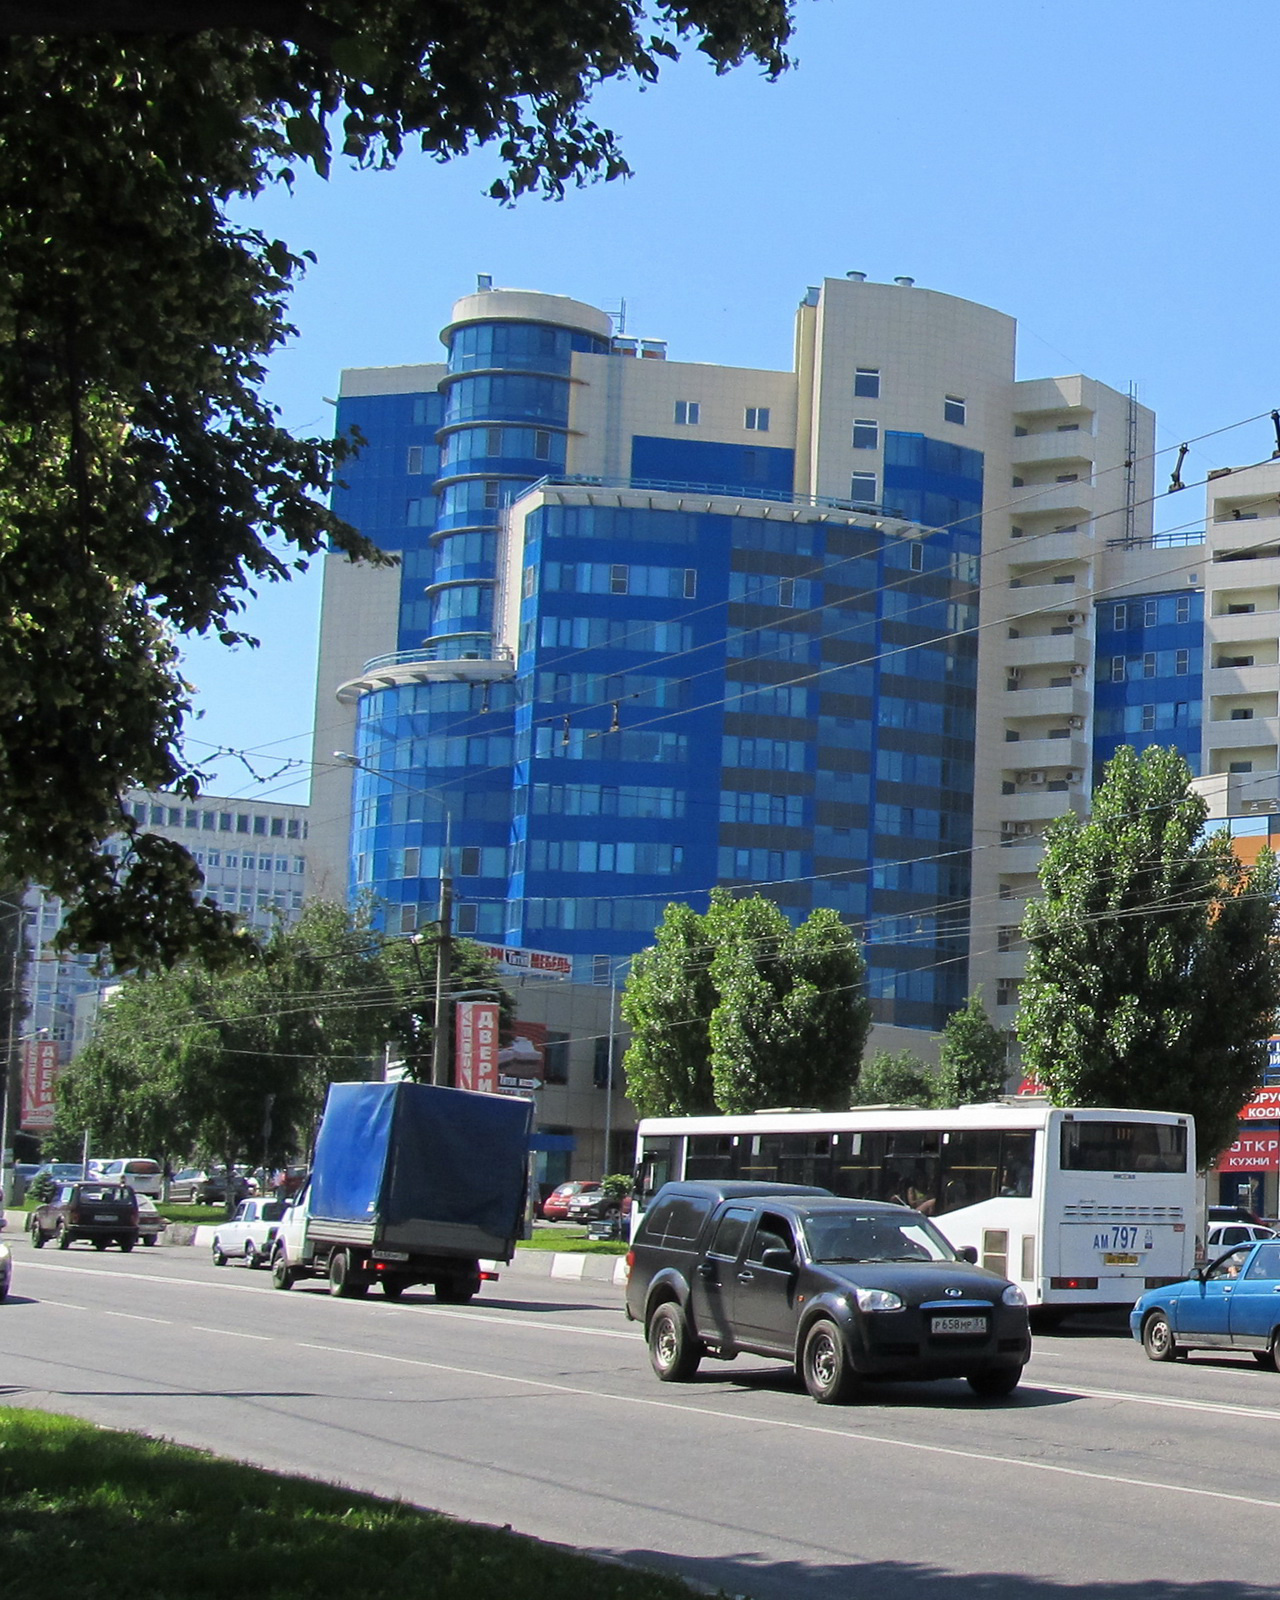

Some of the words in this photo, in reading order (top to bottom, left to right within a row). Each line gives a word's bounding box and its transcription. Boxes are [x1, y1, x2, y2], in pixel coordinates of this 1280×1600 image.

[477, 1011, 494, 1092] ДВЕРИ
[1229, 1157, 1270, 1166] КУХНИ
[1112, 1226, 1138, 1249] 797
